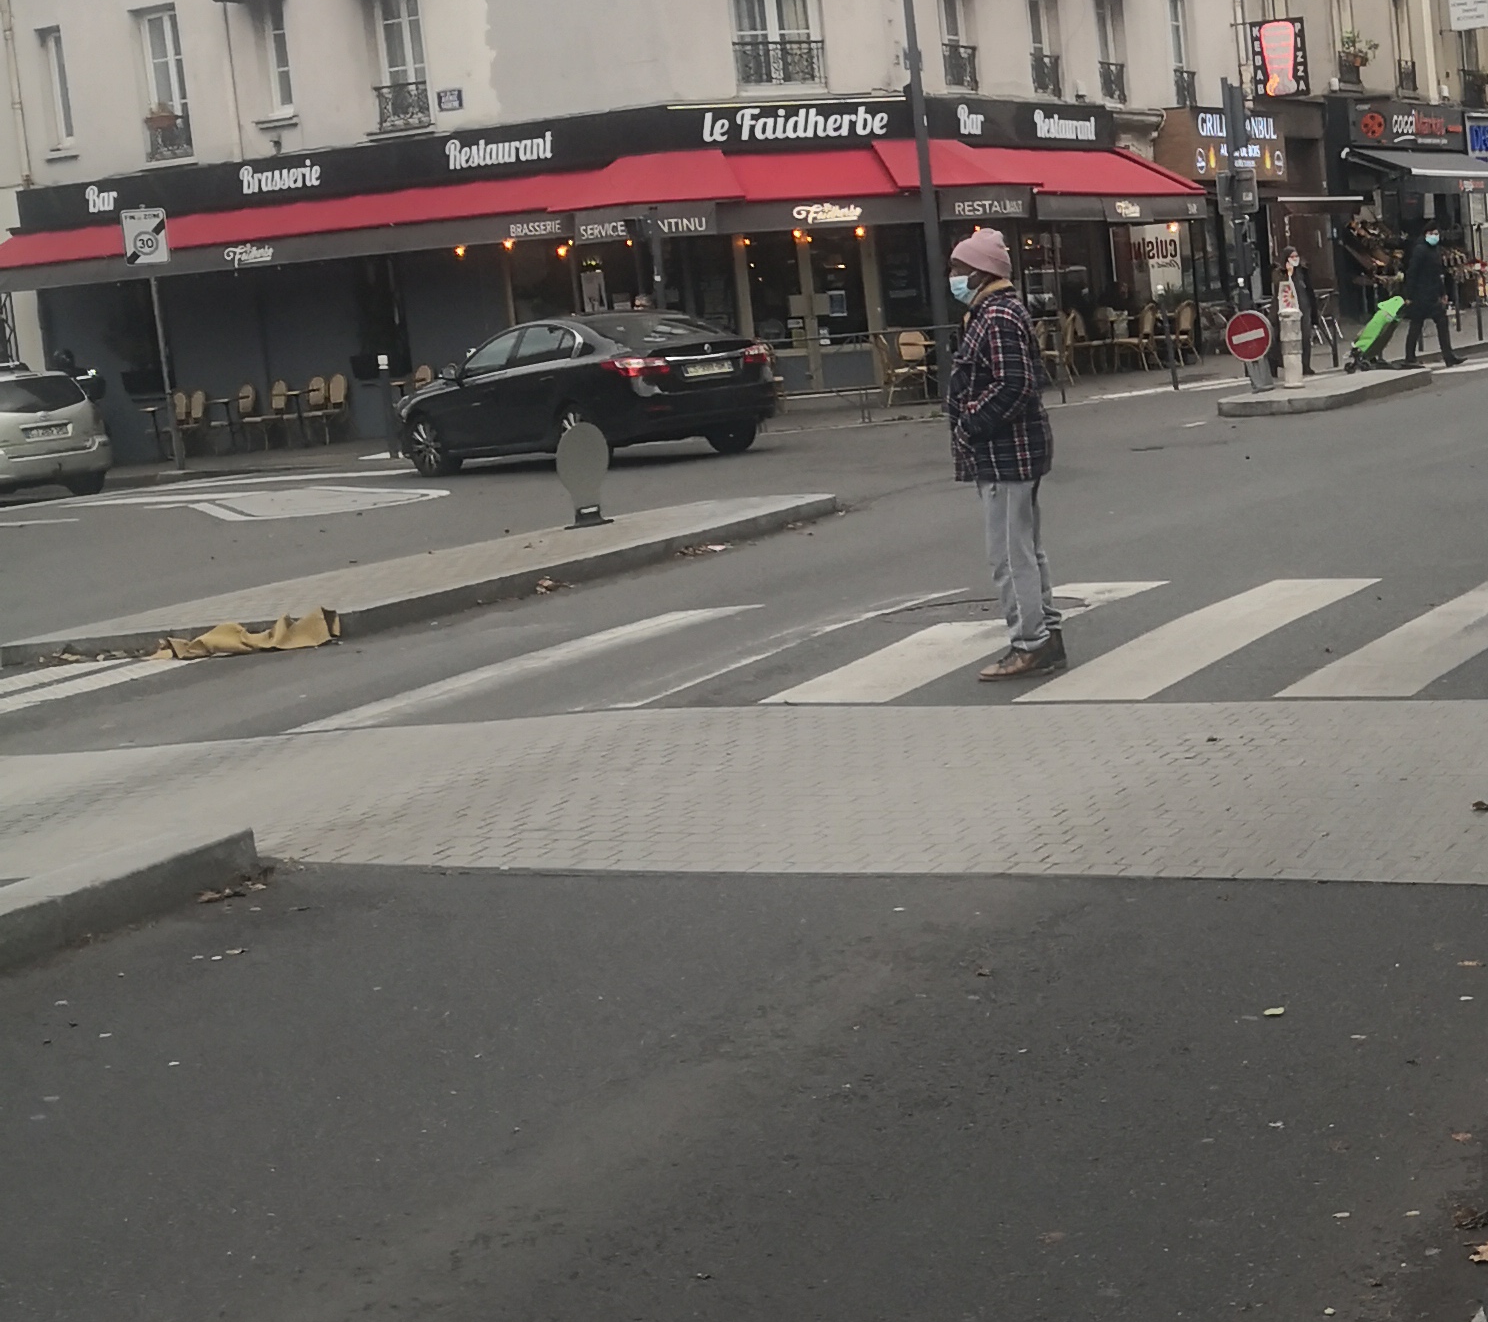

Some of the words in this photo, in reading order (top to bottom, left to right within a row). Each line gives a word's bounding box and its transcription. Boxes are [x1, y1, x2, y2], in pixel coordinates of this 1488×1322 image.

[1252, 26, 1265, 95] KEBAB
[1294, 22, 1306, 91] PIZZA
[702, 112, 729, 143] le
[736, 106, 888, 141] Faidherbe
[957, 104, 984, 135] Bar
[1033, 109, 1096, 141] Restaurant
[445, 130, 553, 170] Restaurant
[239, 159, 321, 194] Brasserie
[85, 185, 118, 213] Bar
[138, 237, 154, 249] 30
[510, 220, 562, 237] BRASSERIE
[580, 221, 626, 239] SERVICE
